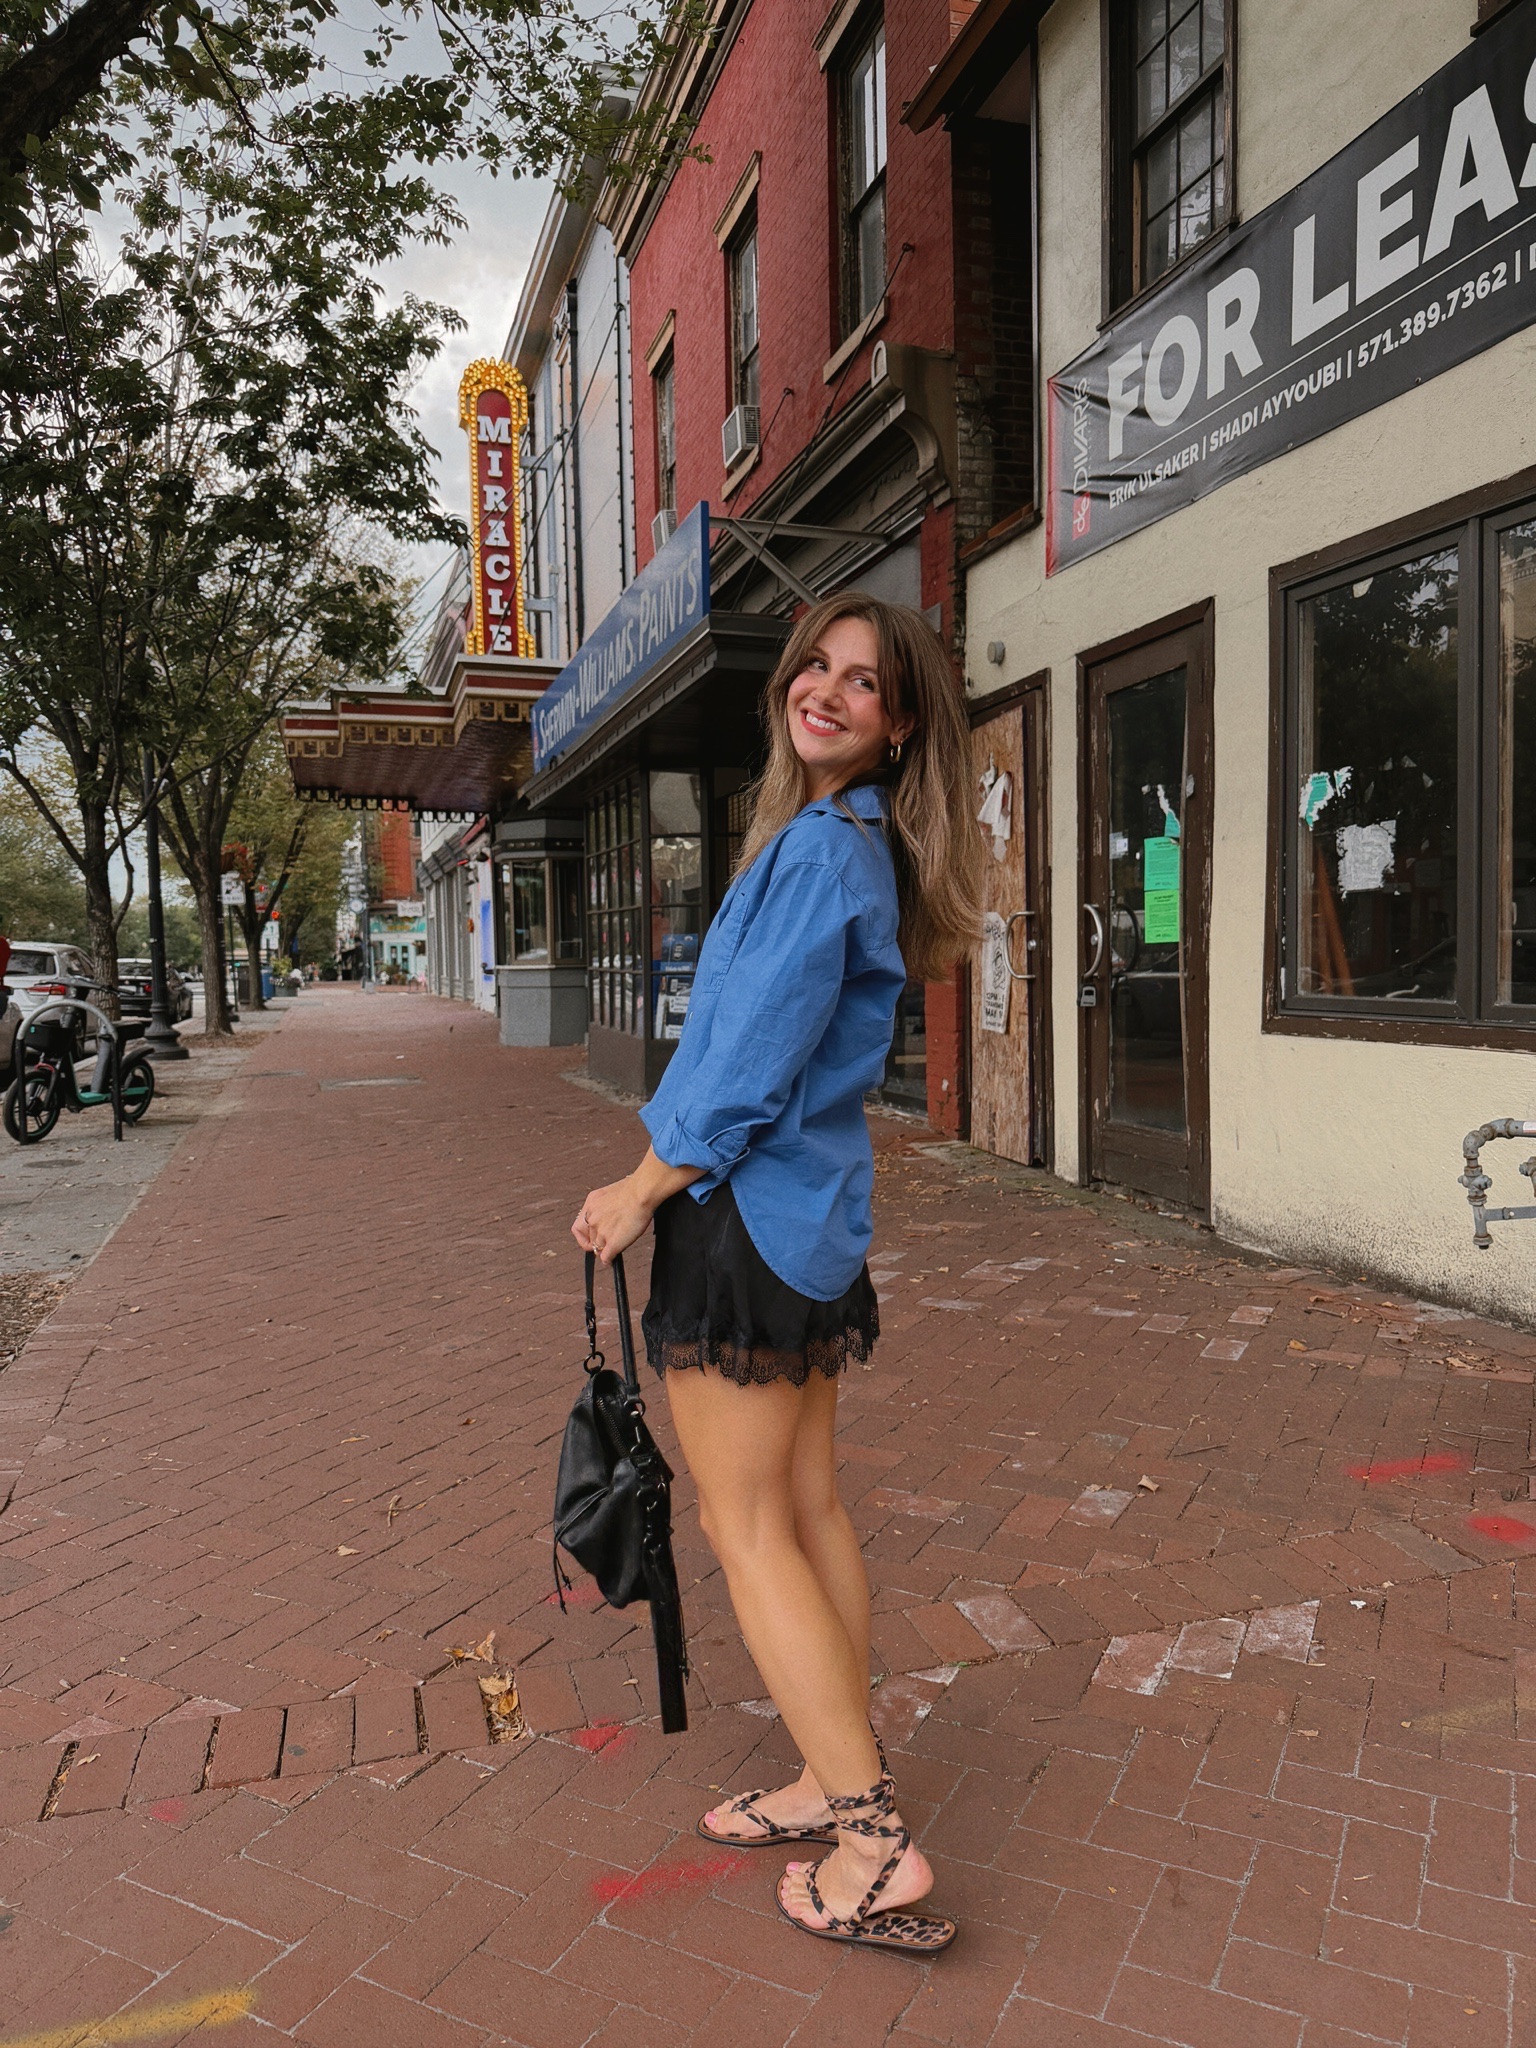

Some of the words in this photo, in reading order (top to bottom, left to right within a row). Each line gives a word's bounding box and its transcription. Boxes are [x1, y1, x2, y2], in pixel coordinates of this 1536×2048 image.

[1108, 267, 1263, 461] FOR
[1291, 55, 1536, 346] LEA
[1073, 377, 1089, 495] DIVARIS
[1109, 477, 1138, 510] ERIK
[1139, 443, 1199, 492] ULSAKER
[1209, 406, 1258, 452] SHADI
[1260, 357, 1342, 424] AYYOUBI
[1357, 261, 1507, 369] 571.389.7362
[477, 415, 513, 653] MIRACLE
[638, 548, 698, 662] PAINTS
